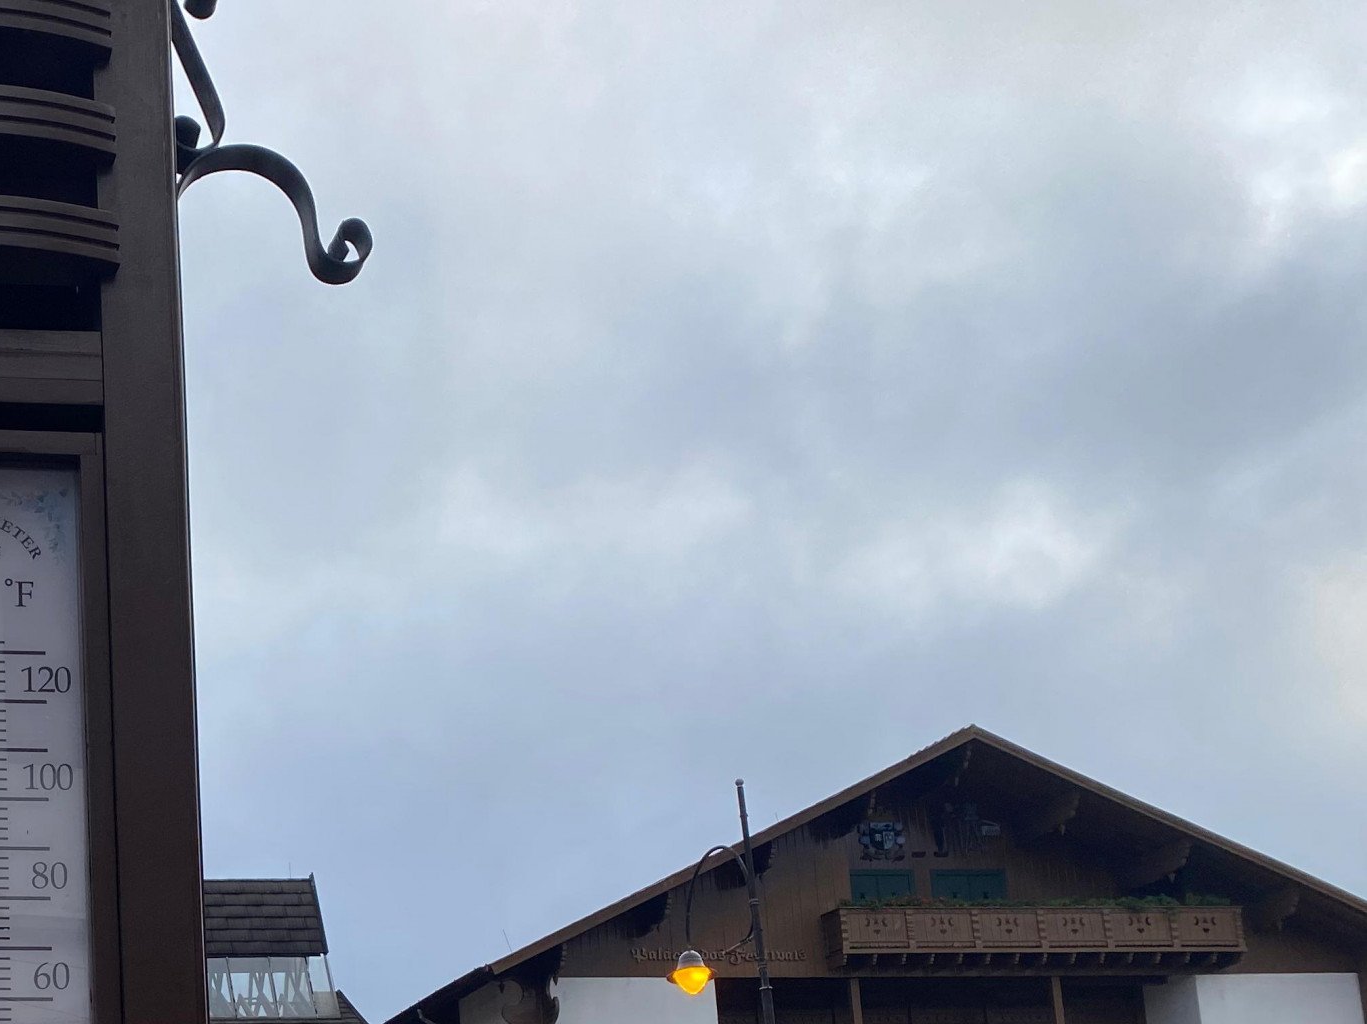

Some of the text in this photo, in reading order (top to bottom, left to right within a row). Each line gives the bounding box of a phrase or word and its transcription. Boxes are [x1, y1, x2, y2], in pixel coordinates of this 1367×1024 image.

[20, 666, 72, 693] 120
[22, 763, 74, 790] 100
[31, 862, 68, 889] 80
[33, 962, 70, 990] 60
